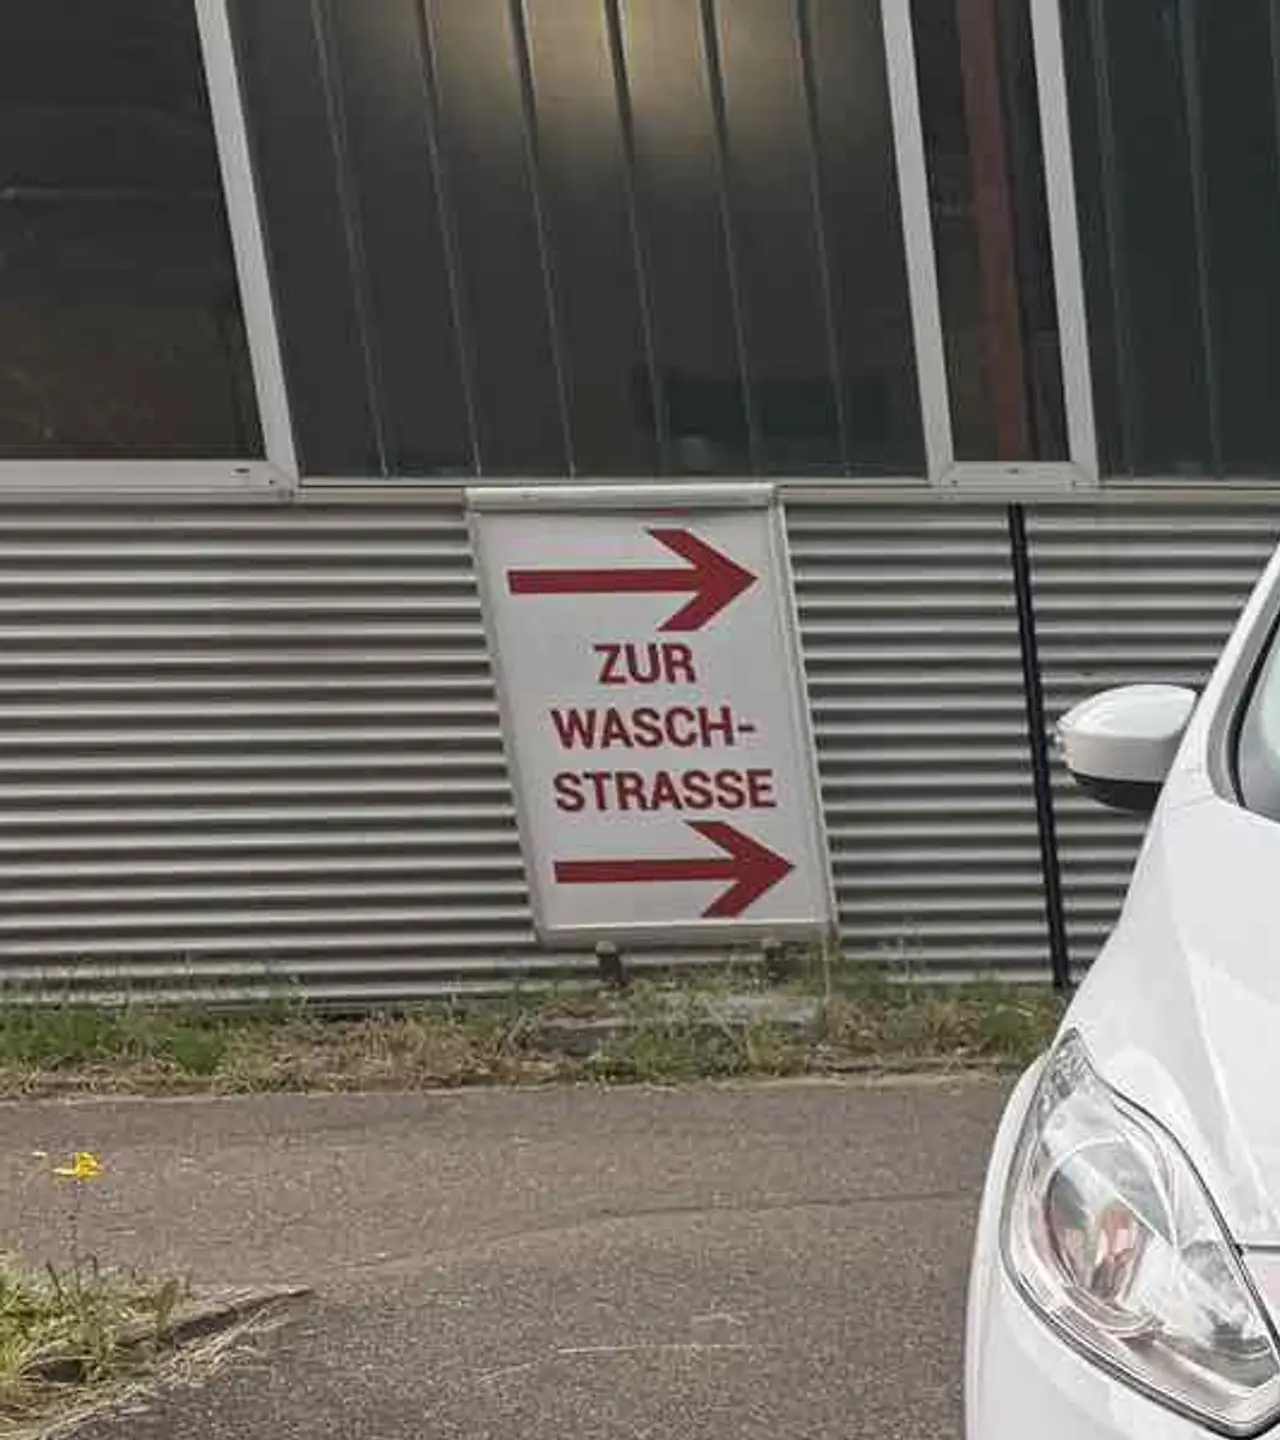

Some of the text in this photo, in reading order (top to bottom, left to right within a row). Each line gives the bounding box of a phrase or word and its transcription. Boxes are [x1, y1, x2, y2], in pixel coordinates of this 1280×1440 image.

[594, 643, 697, 685] ZUR
[551, 706, 756, 750] WASCH-
[552, 768, 776, 812] STRASSE
